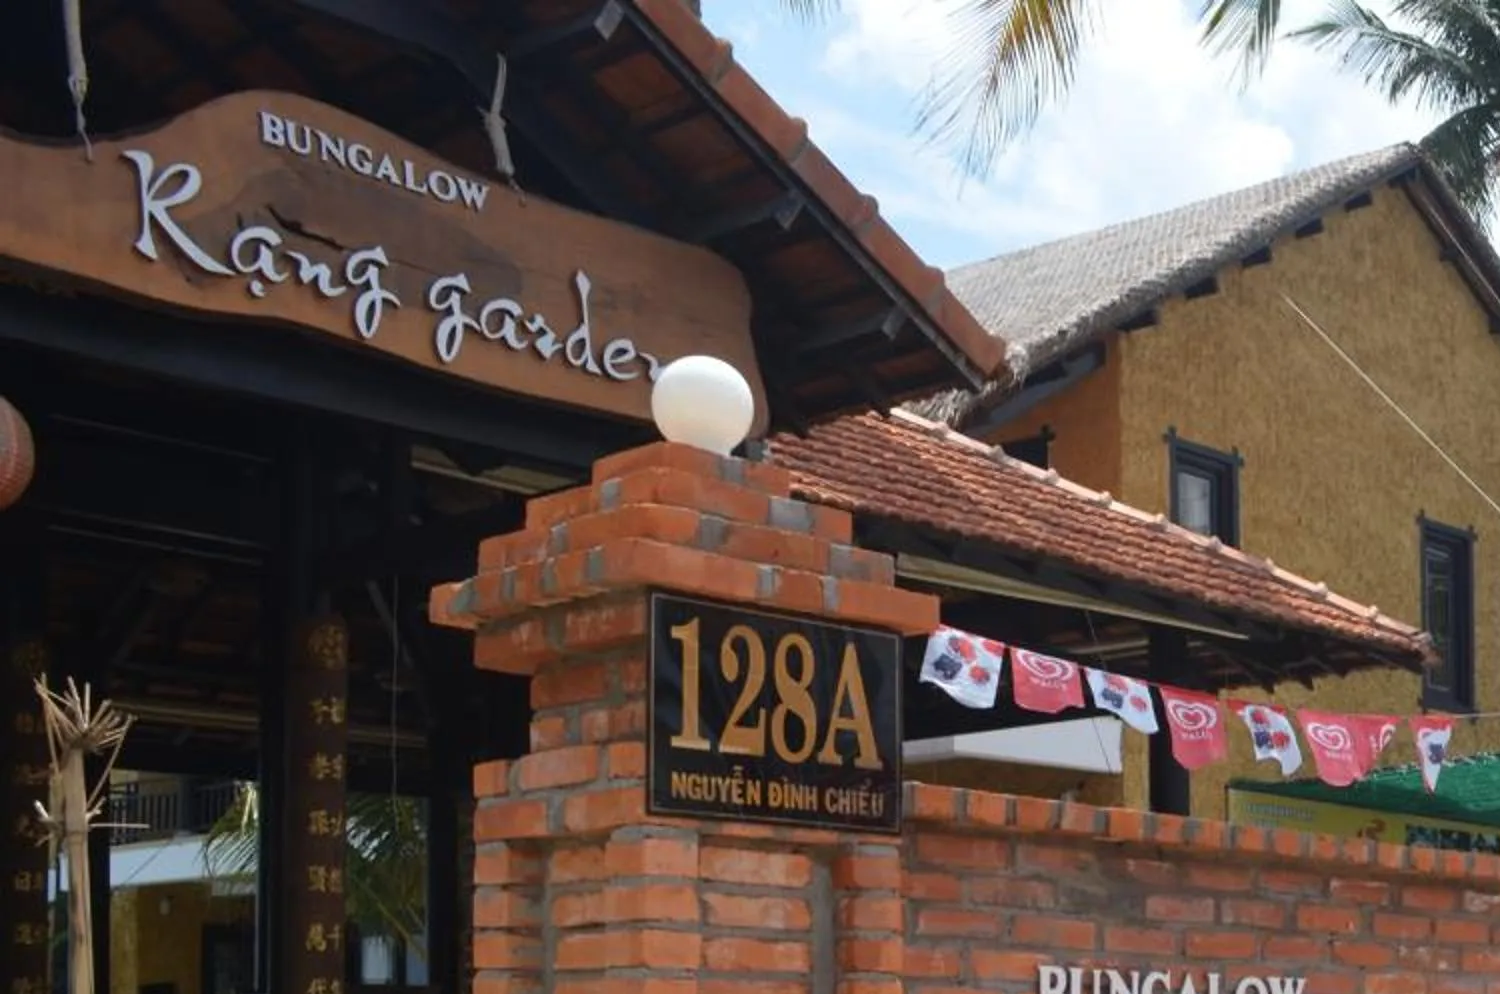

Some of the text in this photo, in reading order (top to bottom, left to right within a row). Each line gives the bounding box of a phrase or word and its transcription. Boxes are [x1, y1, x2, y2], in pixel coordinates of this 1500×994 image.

[258, 111, 489, 211] BUNGALOW
[122, 149, 400, 339] Rạng
[670, 616, 883, 770] 128A
[671, 765, 761, 807] NGUYỄN
[768, 777, 817, 812] ĐÌNH
